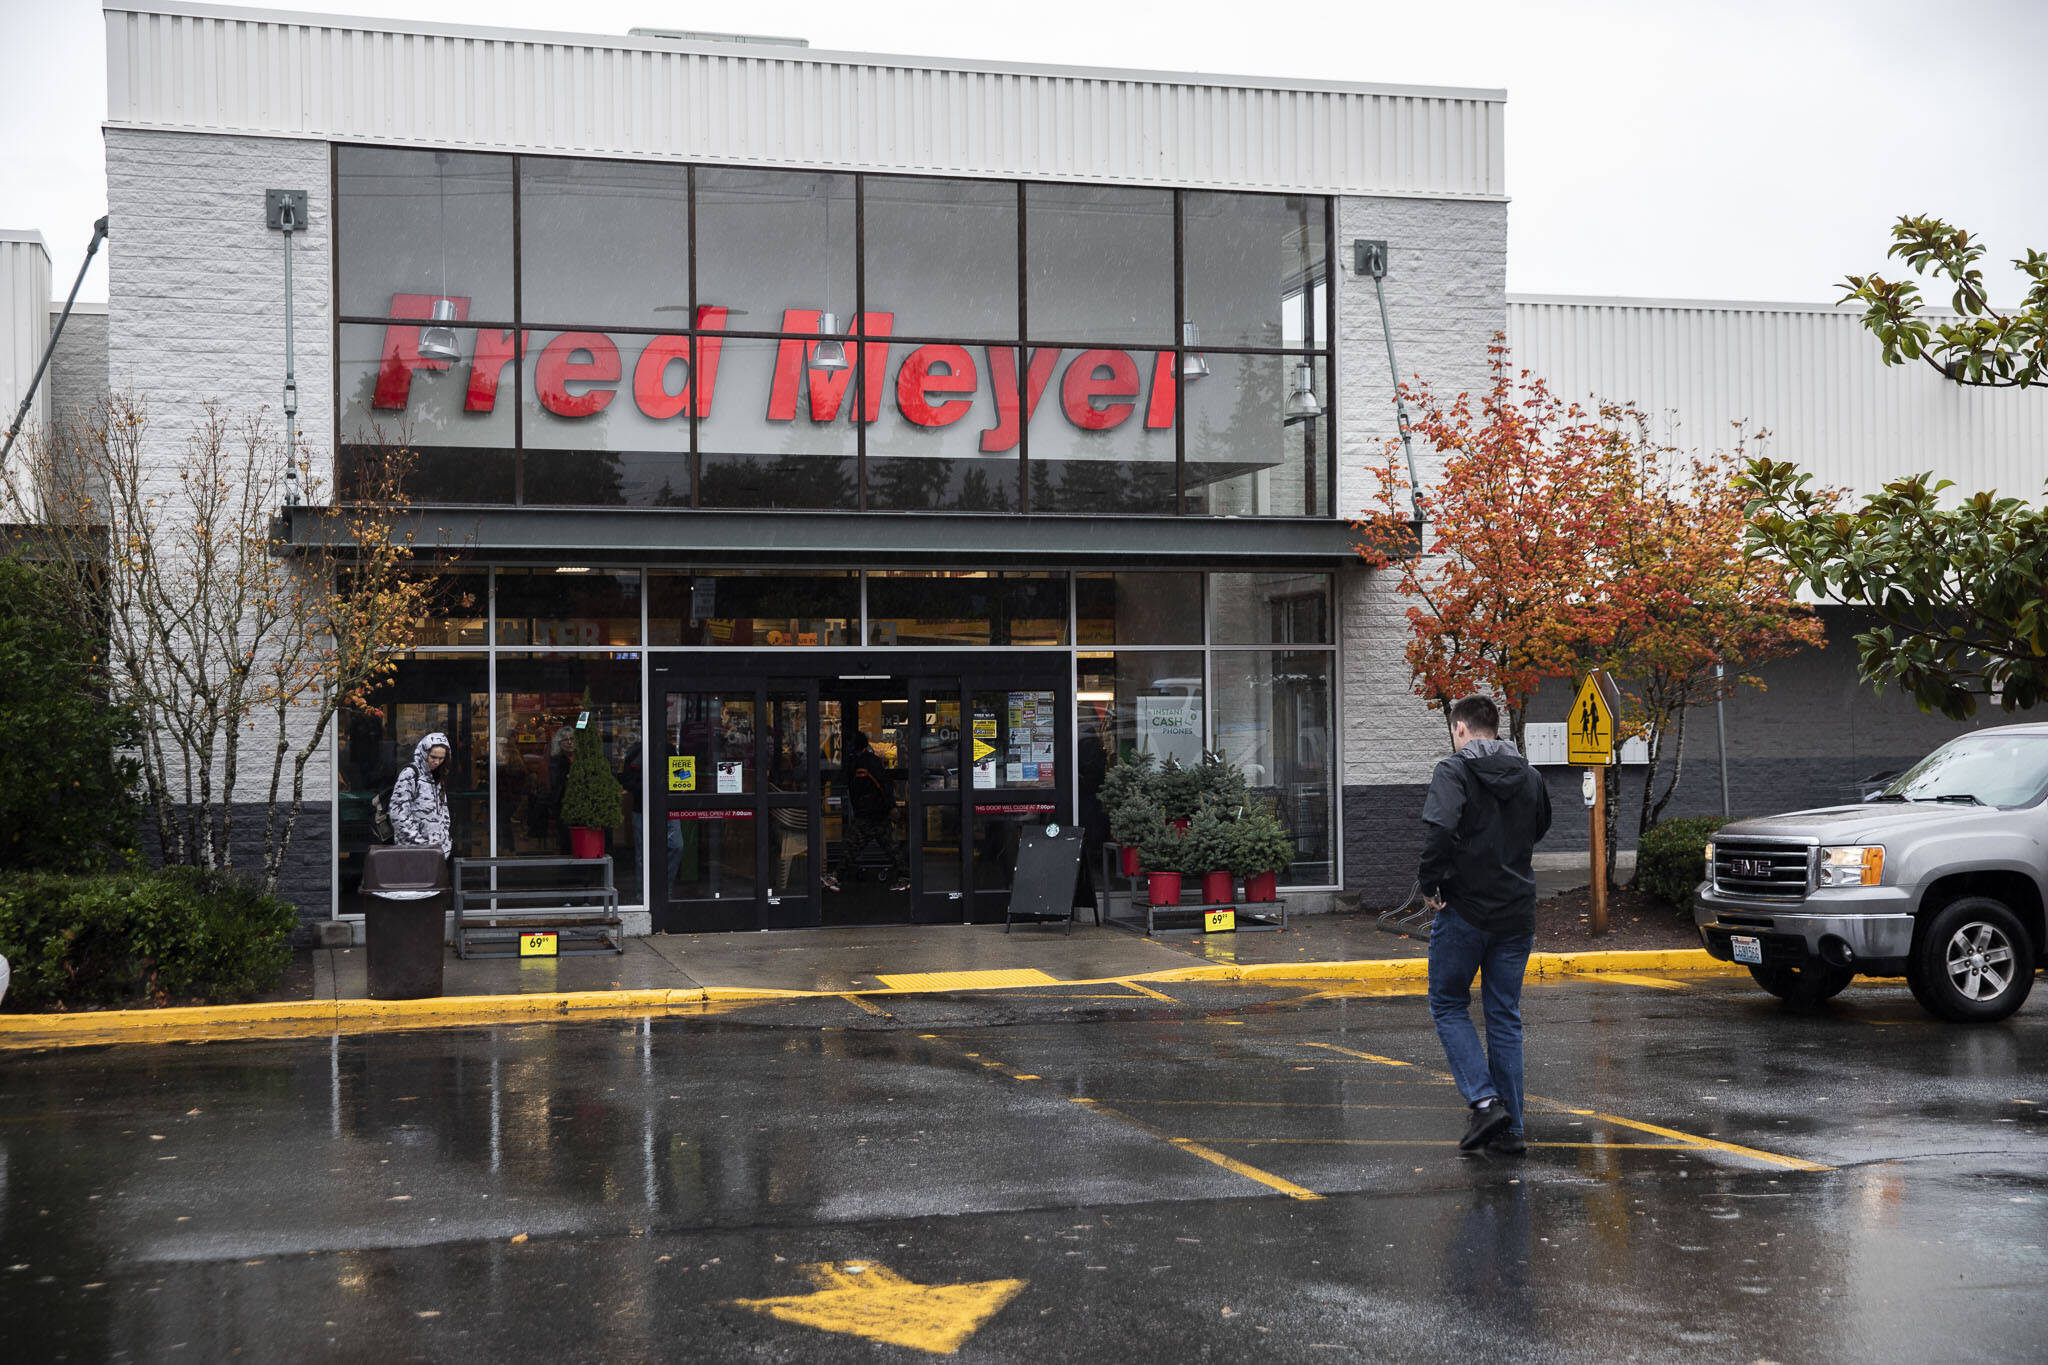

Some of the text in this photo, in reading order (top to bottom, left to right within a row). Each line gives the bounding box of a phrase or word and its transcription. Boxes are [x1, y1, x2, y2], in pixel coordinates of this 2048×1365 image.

[371, 292, 1196, 453] Fred Meyer
[1152, 717, 1183, 726] CASH
[1731, 859, 1772, 877] GMC
